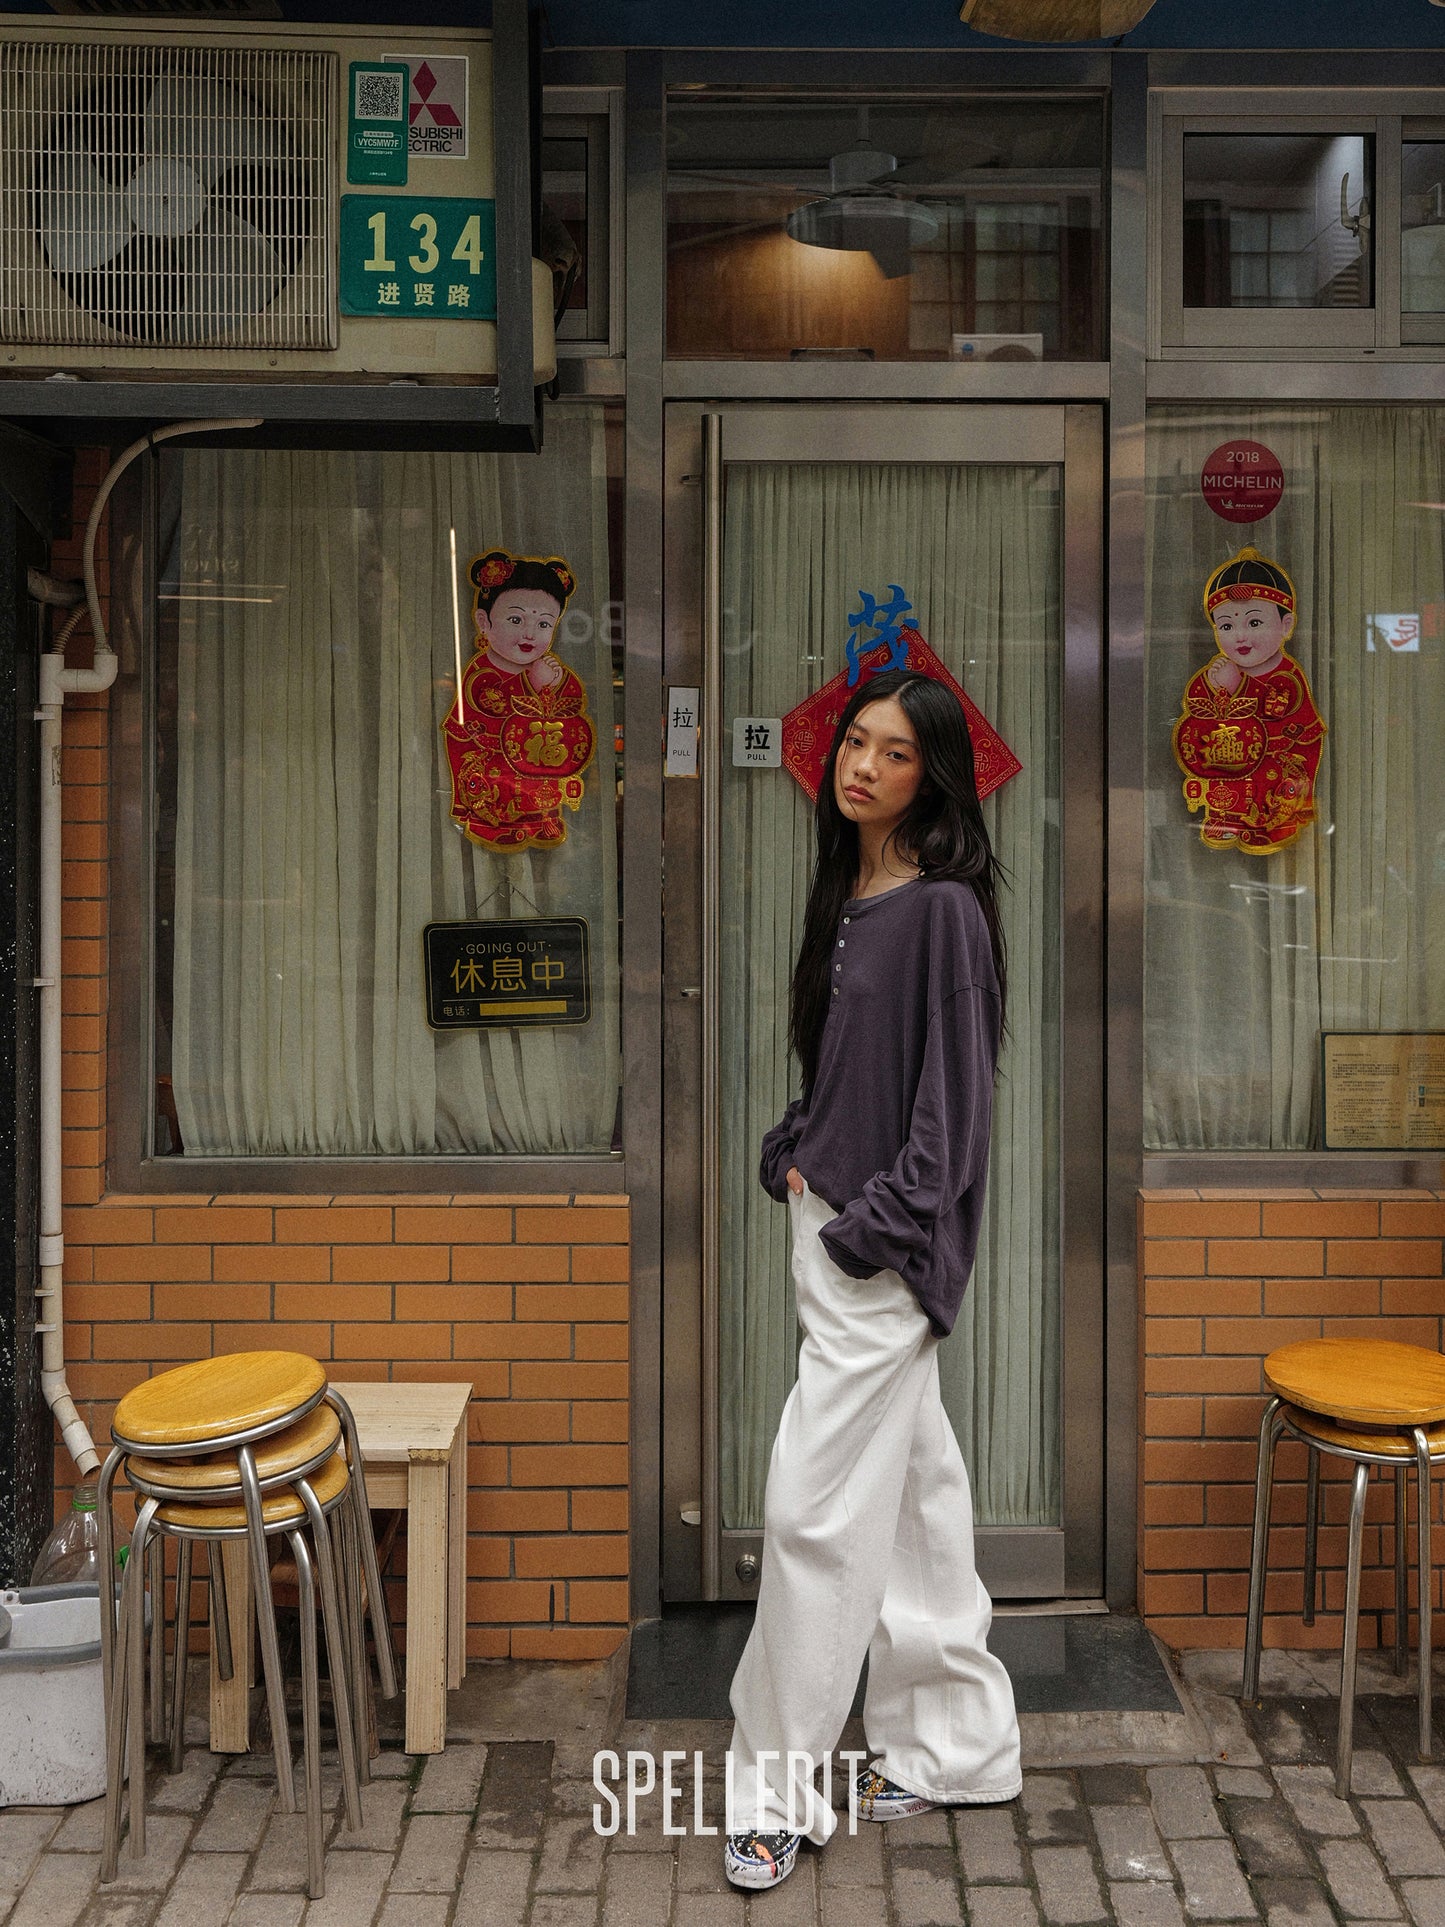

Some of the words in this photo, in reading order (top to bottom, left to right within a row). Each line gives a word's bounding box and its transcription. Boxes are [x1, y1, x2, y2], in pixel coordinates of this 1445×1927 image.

[408, 126, 463, 140] SUBISHI
[363, 211, 484, 275] 134
[377, 282, 471, 307] 进贤路
[1226, 451, 1260, 463] 2018
[1203, 475, 1282, 489] MICHELIN
[673, 707, 694, 728] 拉
[523, 721, 568, 767] 福
[745, 724, 770, 750] 拉
[672, 749, 691, 757] PULL
[747, 753, 767, 761] PULL
[465, 942, 512, 955] GOING
[516, 941, 546, 953] OUT
[450, 955, 565, 994] 休息中
